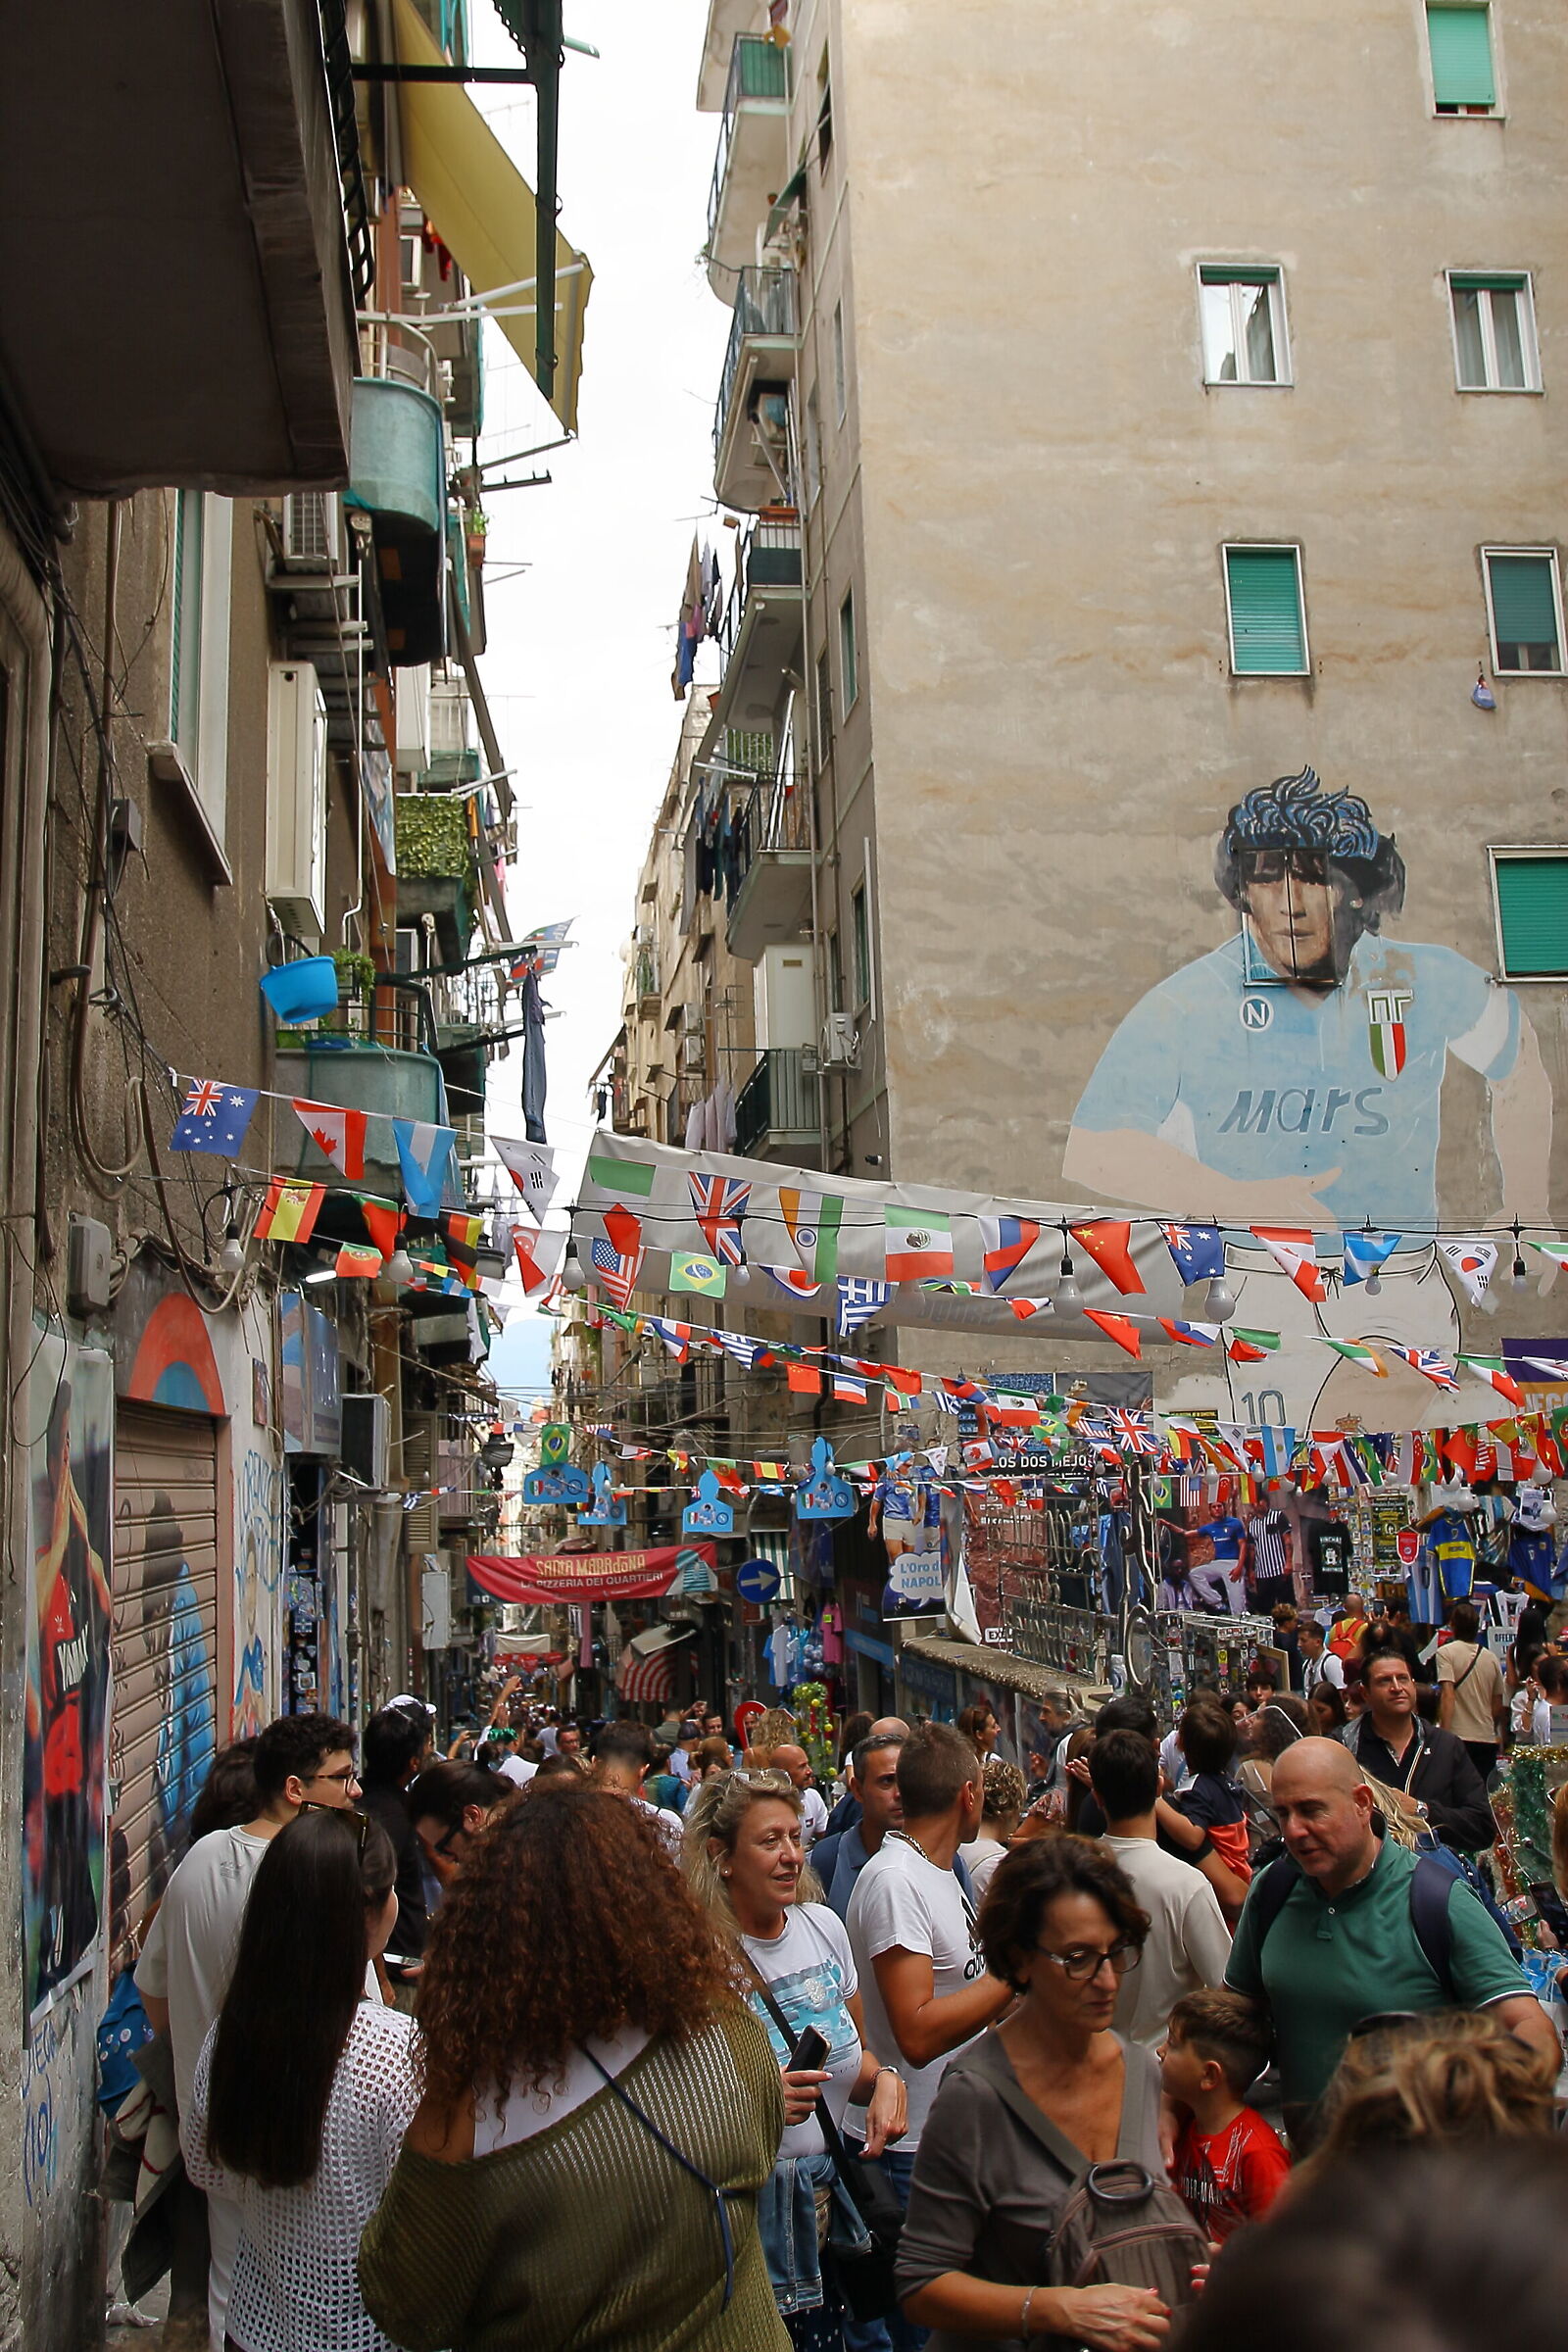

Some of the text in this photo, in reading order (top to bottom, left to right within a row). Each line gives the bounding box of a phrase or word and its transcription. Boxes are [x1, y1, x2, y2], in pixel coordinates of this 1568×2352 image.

[1247, 1003, 1266, 1026] N
[1241, 1389, 1288, 1427] 10
[1020, 1456, 1048, 1468] DOS
[900, 1560, 941, 1574] L'Oro d
[536, 1577, 584, 1589] PIZZERIA
[586, 1576, 603, 1587] DEI
[607, 1572, 663, 1586] QUARTIERI
[901, 1576, 941, 1589] NAPOL
[1494, 1633, 1518, 1642] OFFERT
